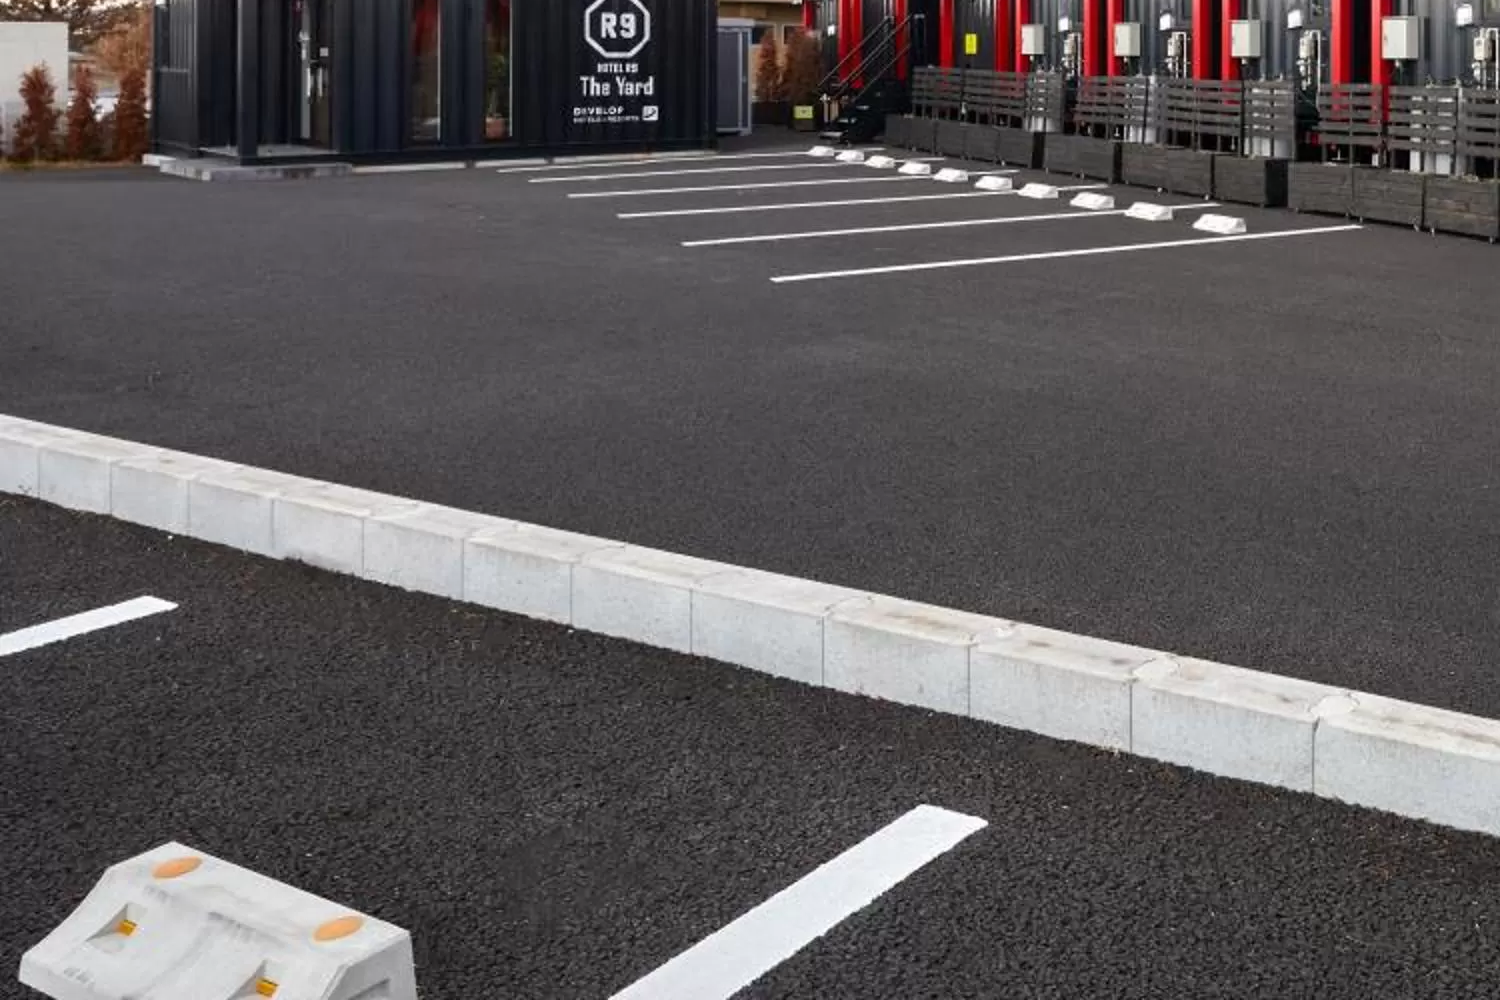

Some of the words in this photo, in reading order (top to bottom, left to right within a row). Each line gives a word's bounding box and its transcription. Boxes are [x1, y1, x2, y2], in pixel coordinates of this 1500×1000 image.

[601, 12, 637, 39] R9
[580, 75, 611, 96] The
[615, 75, 654, 96] Yard
